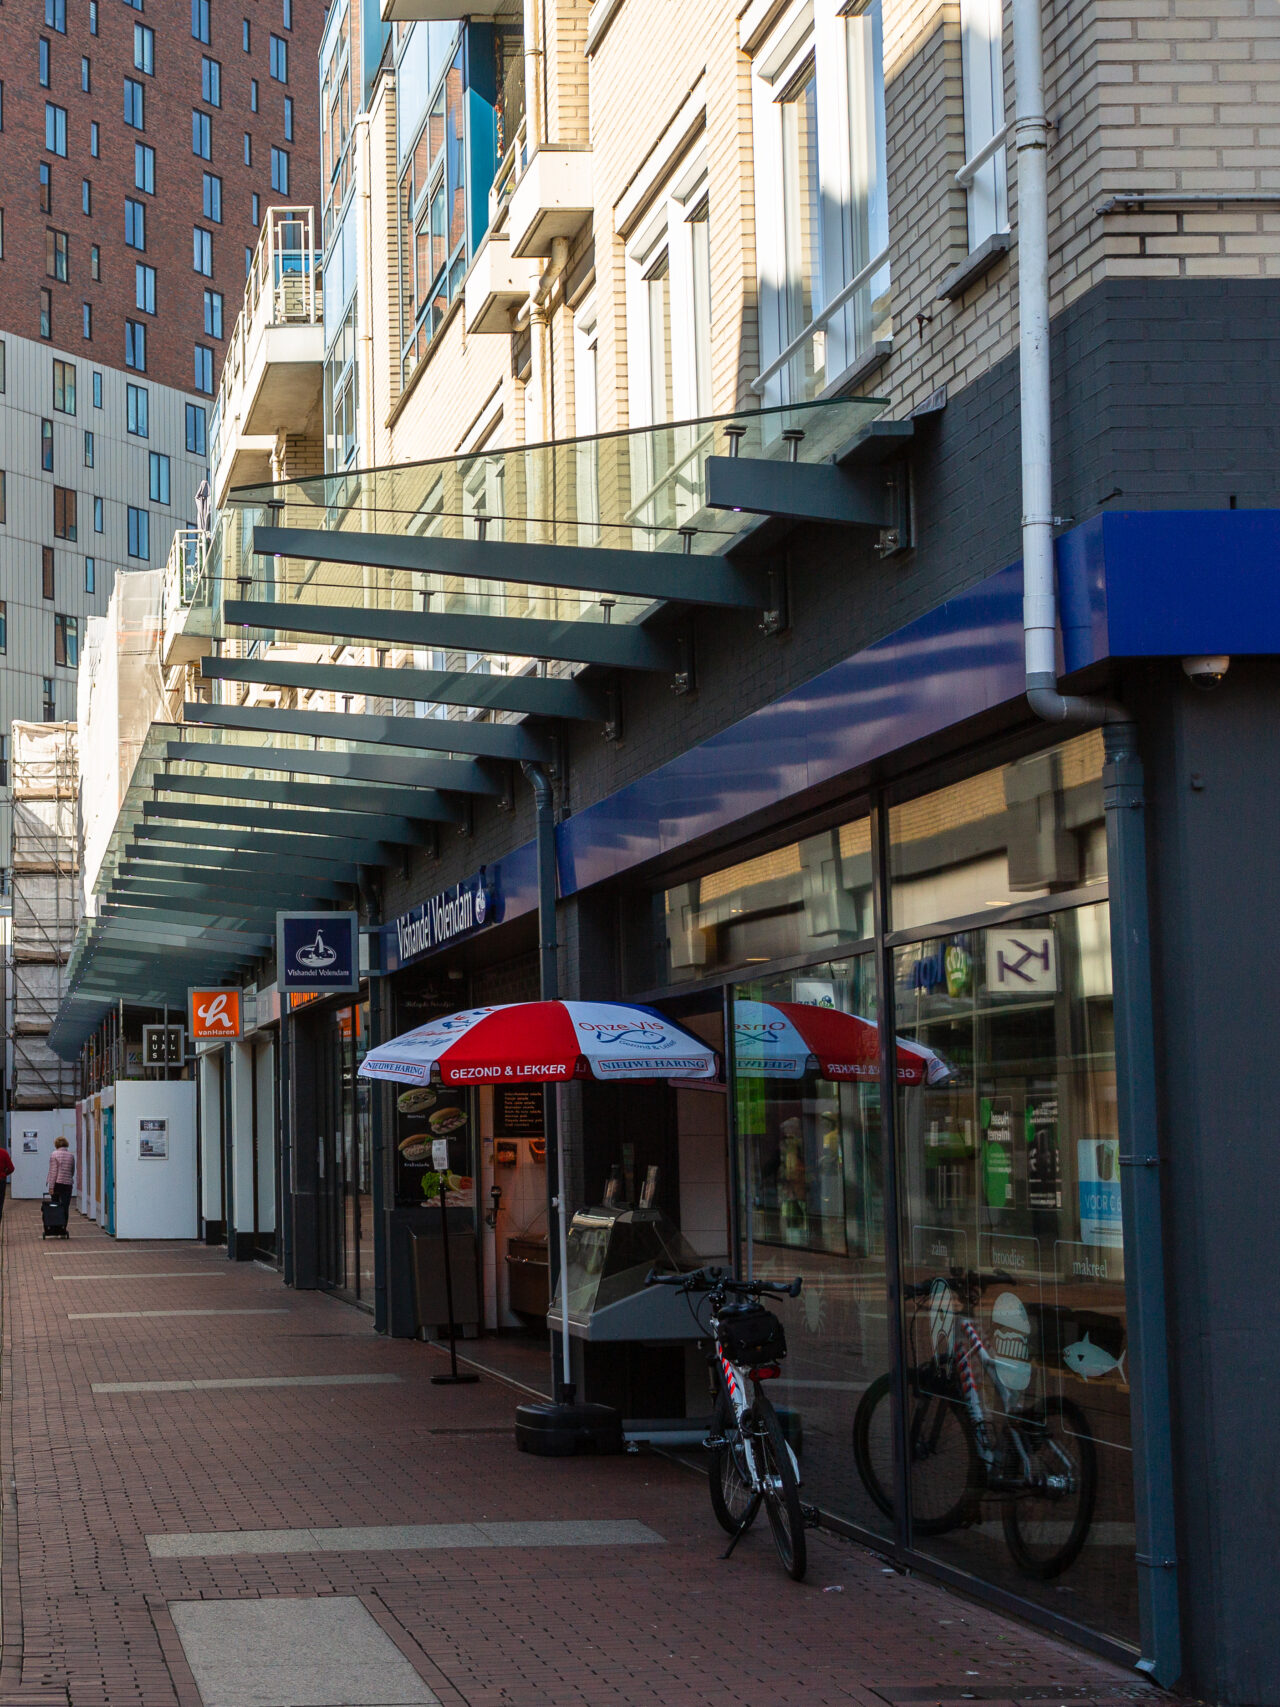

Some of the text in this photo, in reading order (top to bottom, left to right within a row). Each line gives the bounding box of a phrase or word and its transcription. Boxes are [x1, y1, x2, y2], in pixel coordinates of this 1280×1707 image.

[396, 883, 473, 961] Vishandel Volendam
[287, 969, 350, 977] Vishandel Volendam
[578, 1021, 665, 1031] Onze Vis
[366, 1060, 424, 1076] NIEUWE HARING
[450, 1066, 501, 1080] GEZOND
[504, 1066, 514, 1076] &
[517, 1064, 567, 1077] LEKKER
[601, 1060, 706, 1070] NIEUWE HARING
[1084, 1193, 1108, 1211] VOOR
[931, 1240, 948, 1257] zalm
[992, 1248, 1025, 1272] broodjes
[1072, 1257, 1108, 1279] makreel
